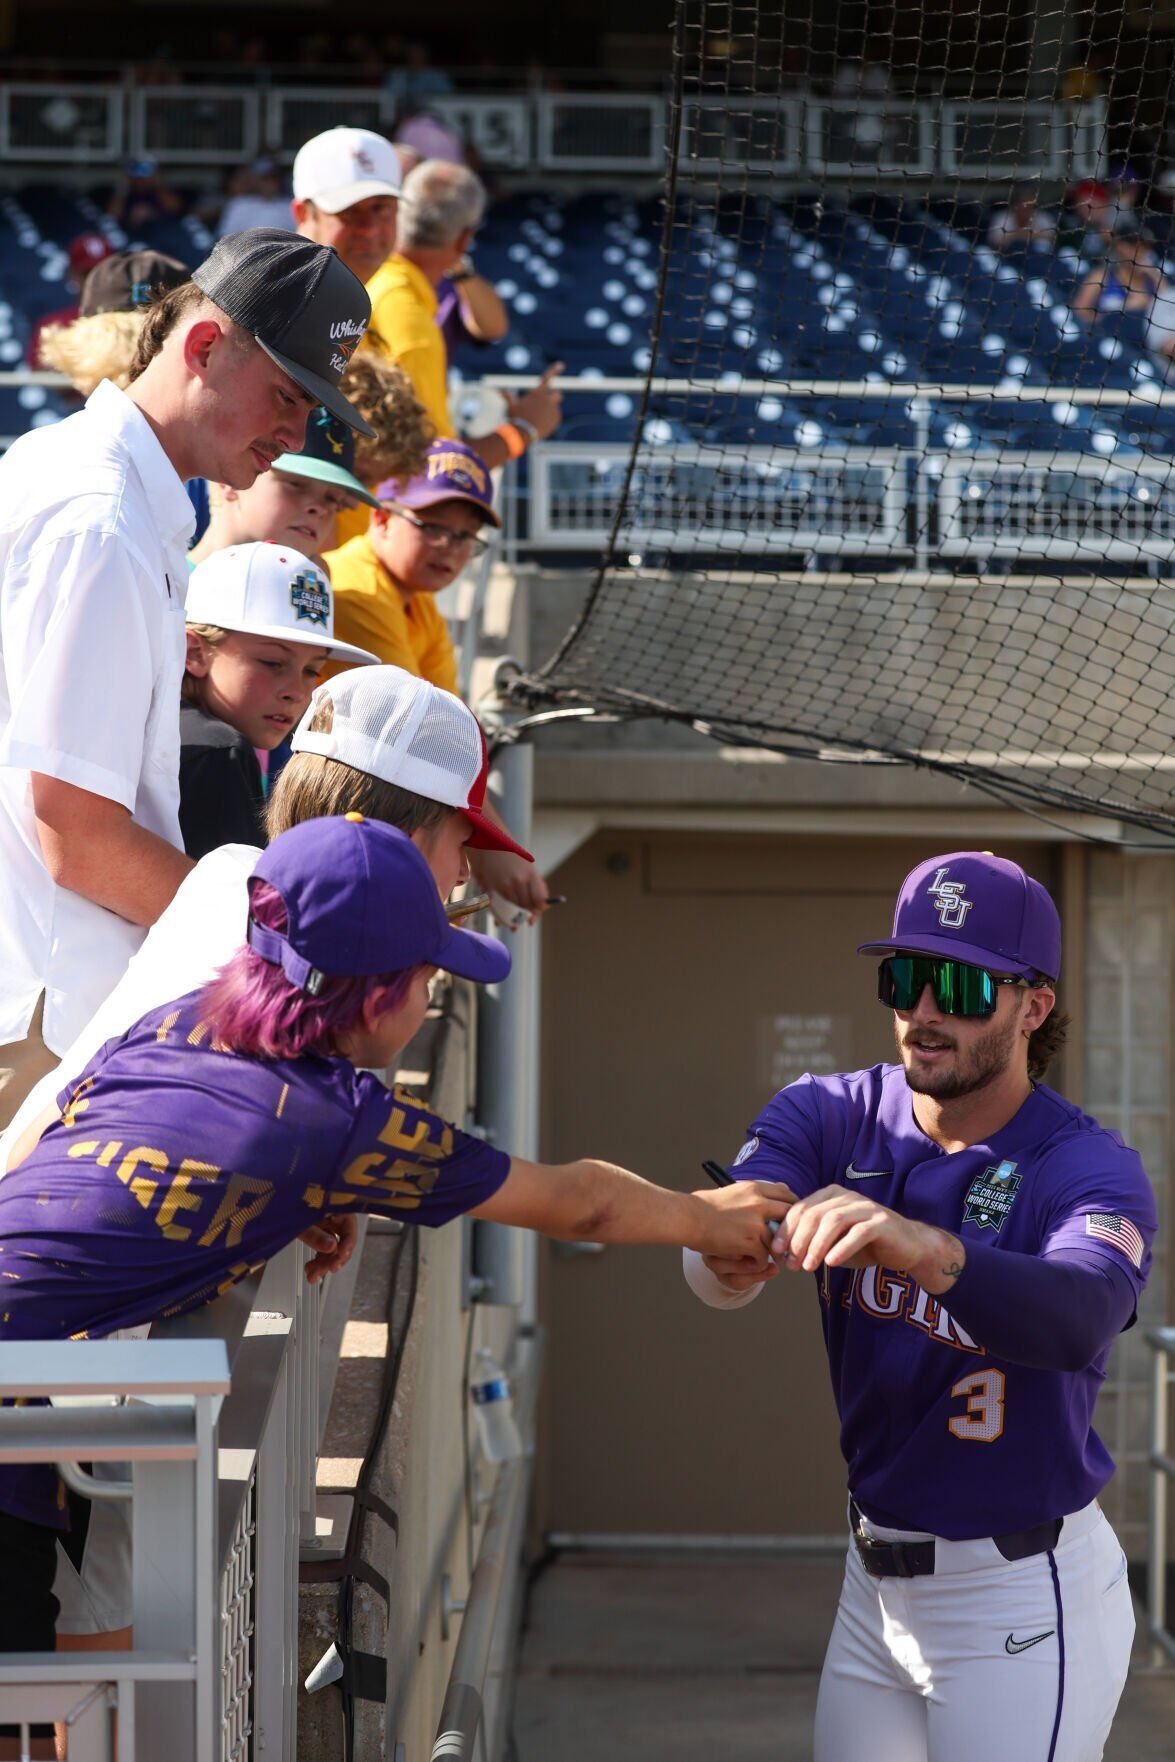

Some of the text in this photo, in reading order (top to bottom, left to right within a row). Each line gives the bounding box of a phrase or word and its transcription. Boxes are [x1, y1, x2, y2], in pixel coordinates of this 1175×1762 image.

[926, 867, 974, 930] LSU
[966, 1194, 991, 1209] WORLD
[979, 1188, 1009, 1203] COLLEGE
[948, 1367, 1006, 1443] 3
